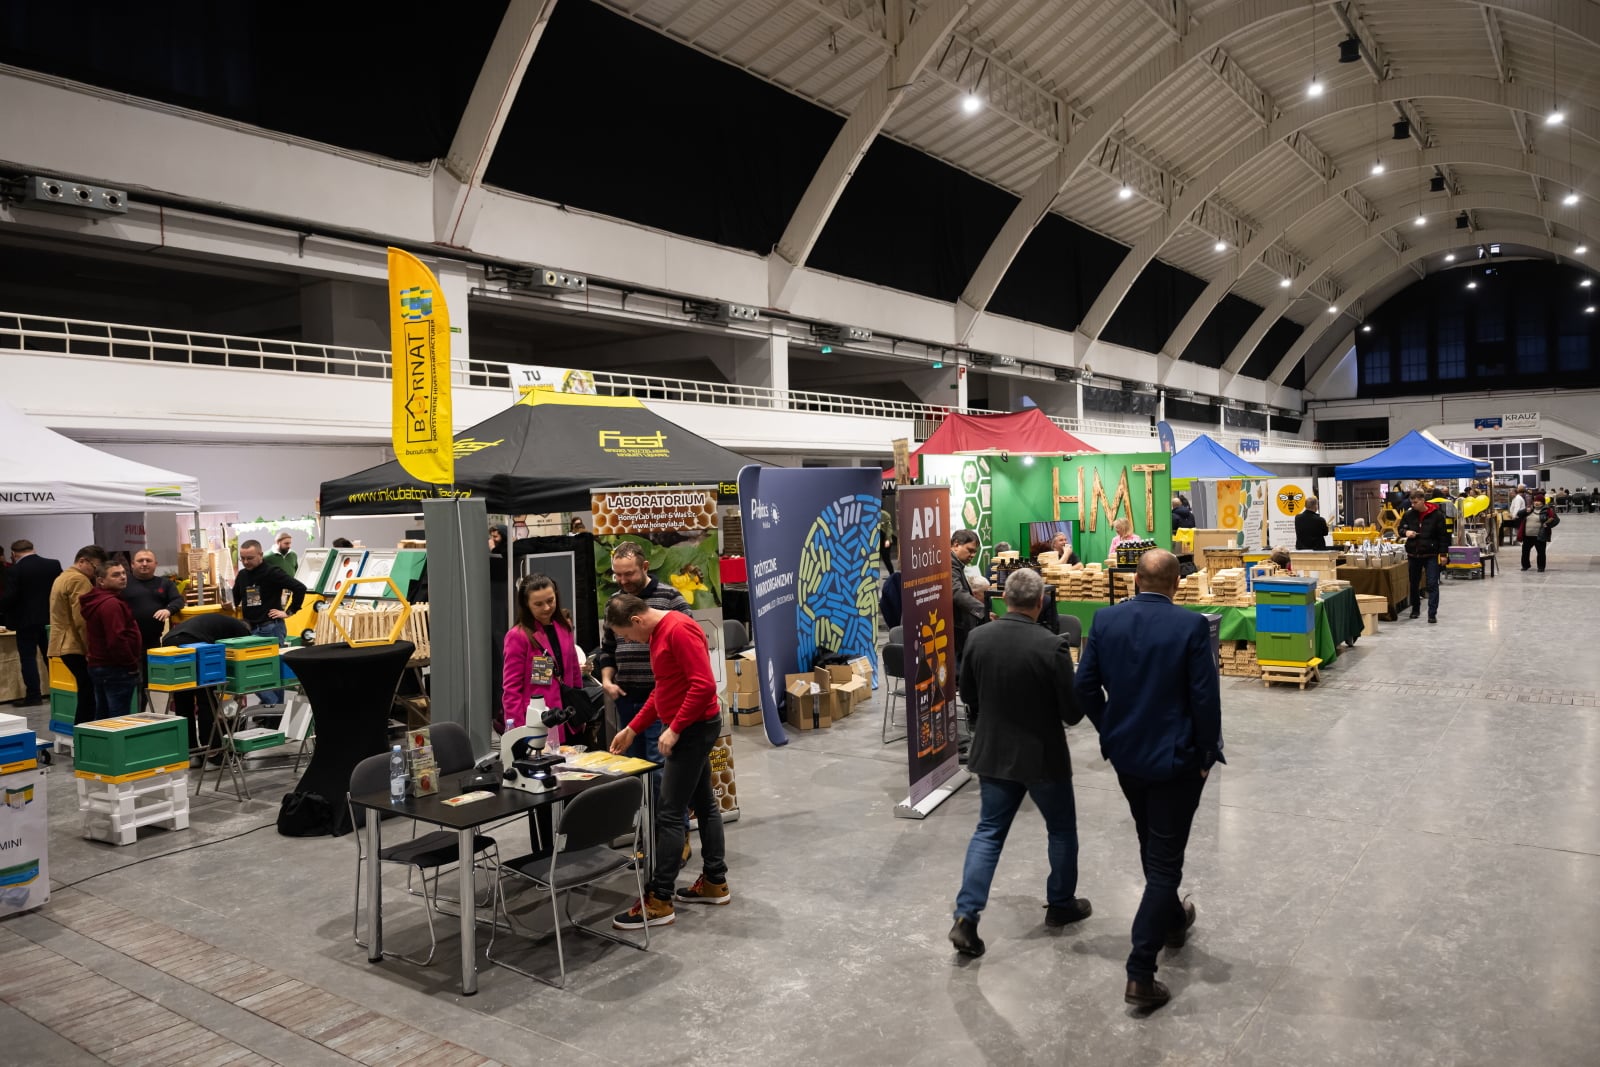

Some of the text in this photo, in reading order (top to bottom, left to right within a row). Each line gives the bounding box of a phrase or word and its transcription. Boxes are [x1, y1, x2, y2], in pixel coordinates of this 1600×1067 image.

[522, 370, 541, 381] TU
[0, 492, 56, 502] NICTWA
[607, 493, 705, 508] LABORATORIUM
[1052, 463, 1166, 532] HMT
[618, 513, 650, 521] HoneyLab
[632, 520, 685, 528] www.honeylab.pl
[911, 545, 942, 569] biotic
[0, 838, 22, 850] MINI
